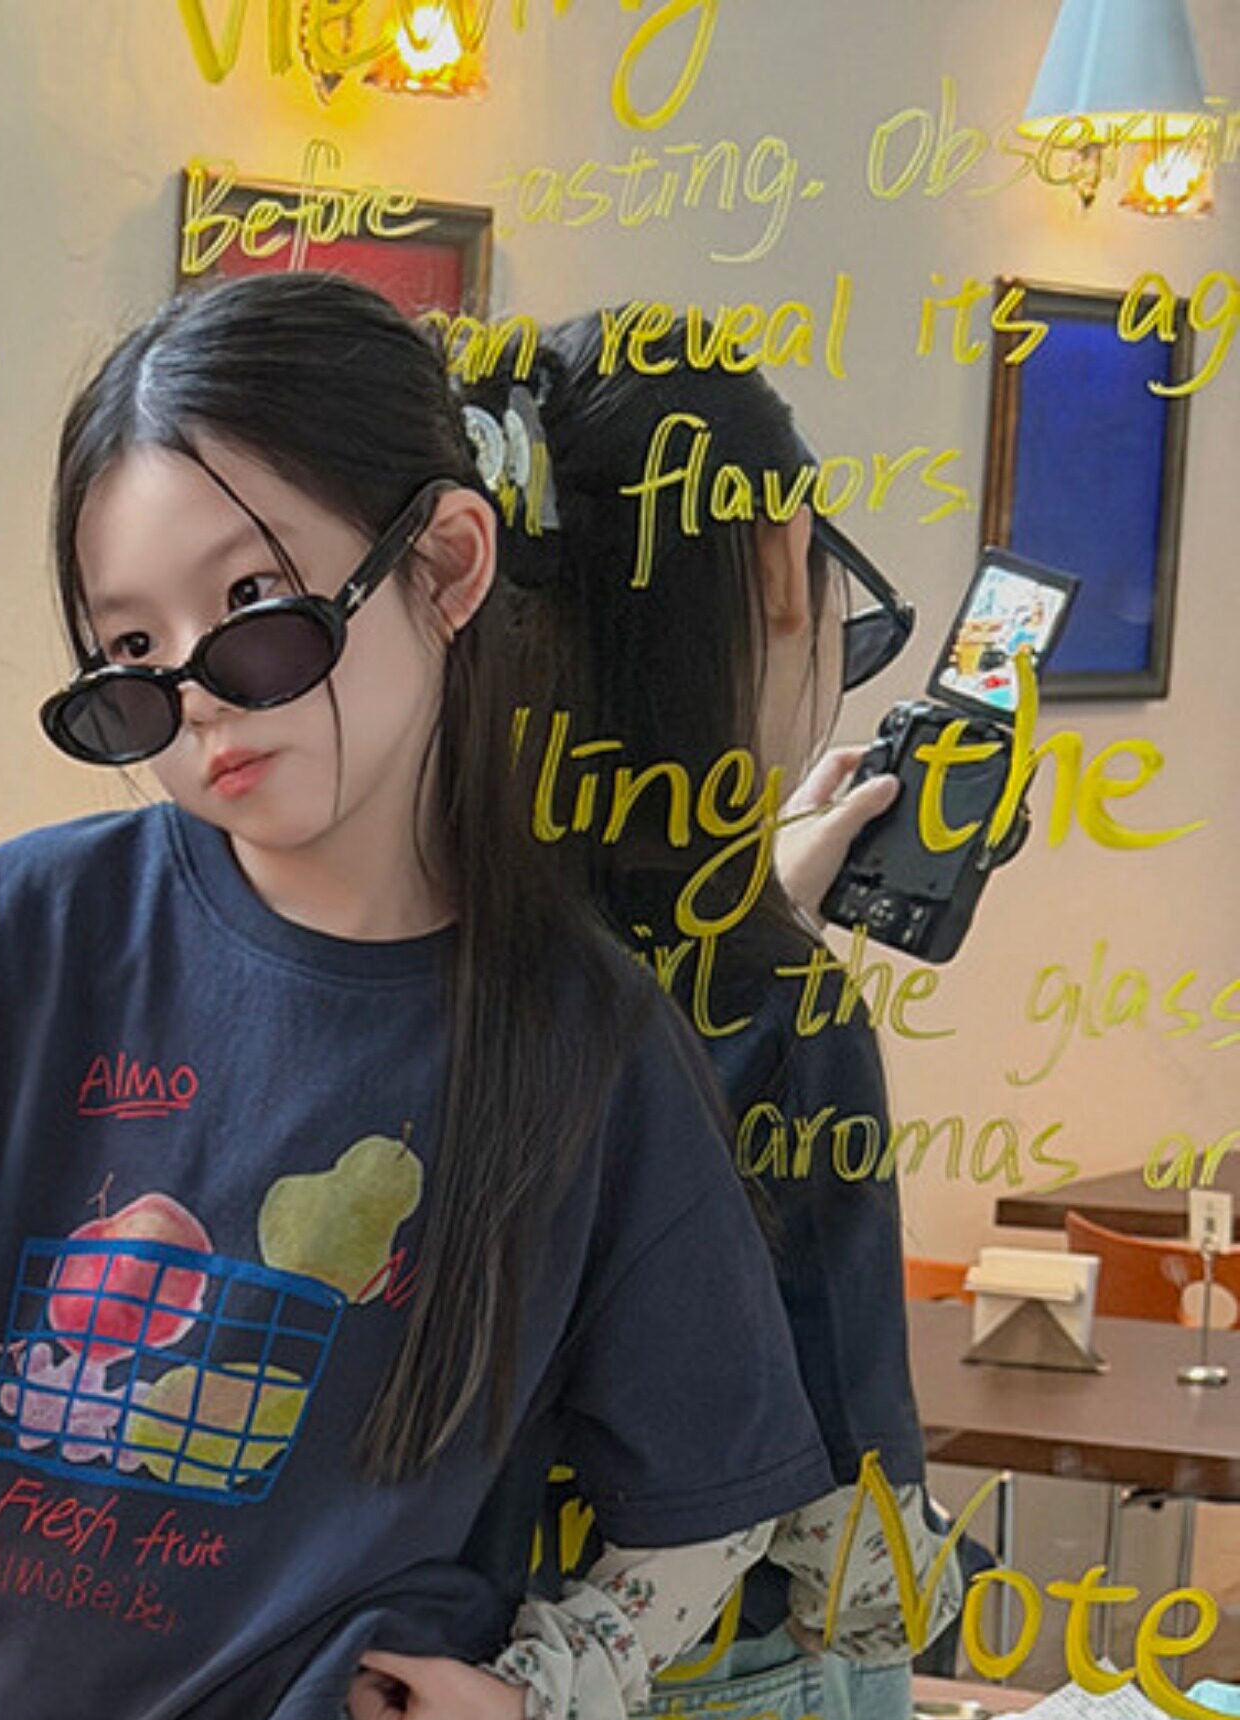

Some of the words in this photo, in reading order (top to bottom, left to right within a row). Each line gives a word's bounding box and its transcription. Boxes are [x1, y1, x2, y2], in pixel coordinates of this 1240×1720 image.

[180, 138, 438, 276] Before
[598, 272, 854, 378] reveal
[915, 272, 1050, 366] its
[915, 650, 1210, 852] the
[776, 922, 958, 1040] the
[736, 1100, 1080, 1196] aromas
[132, 1508, 228, 1568] fruit
